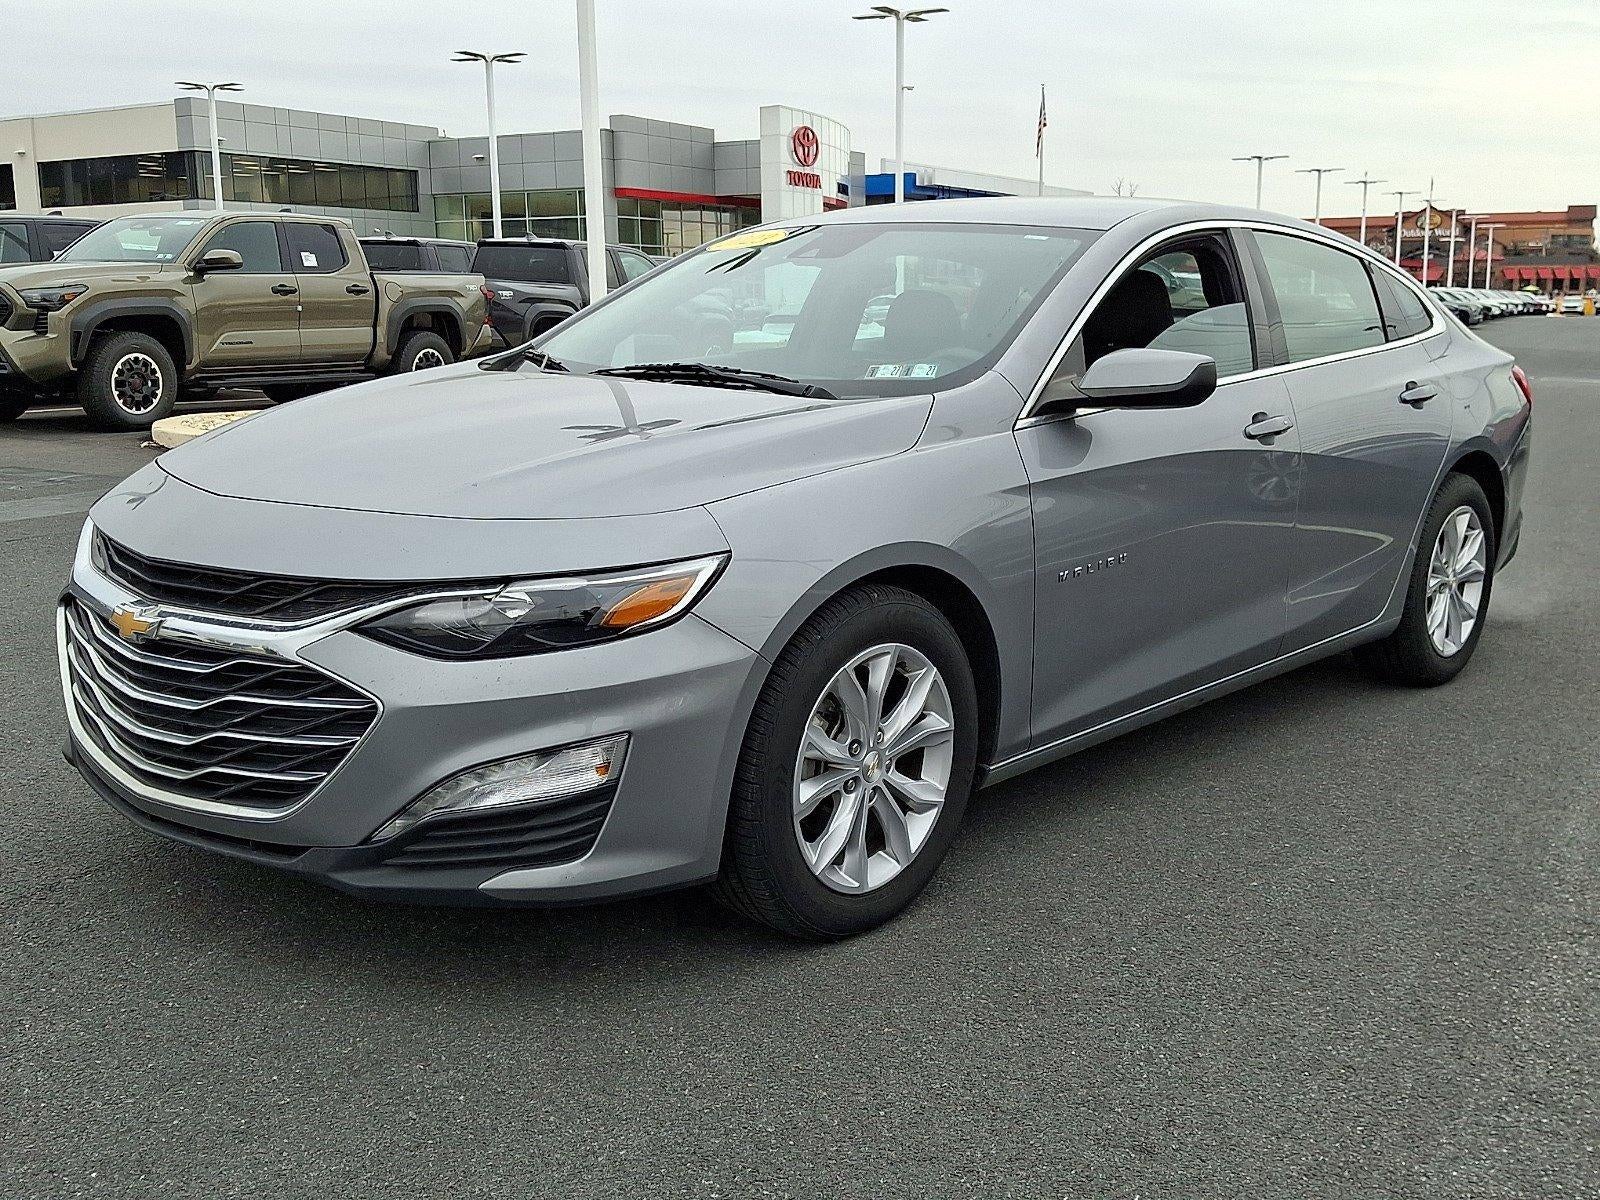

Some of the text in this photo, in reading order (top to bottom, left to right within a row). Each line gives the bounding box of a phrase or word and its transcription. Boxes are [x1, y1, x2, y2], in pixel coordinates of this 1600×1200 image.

[786, 170, 822, 189] TOYOTA
[926, 365, 936, 376] 27
[1058, 552, 1128, 583] MALIBU
